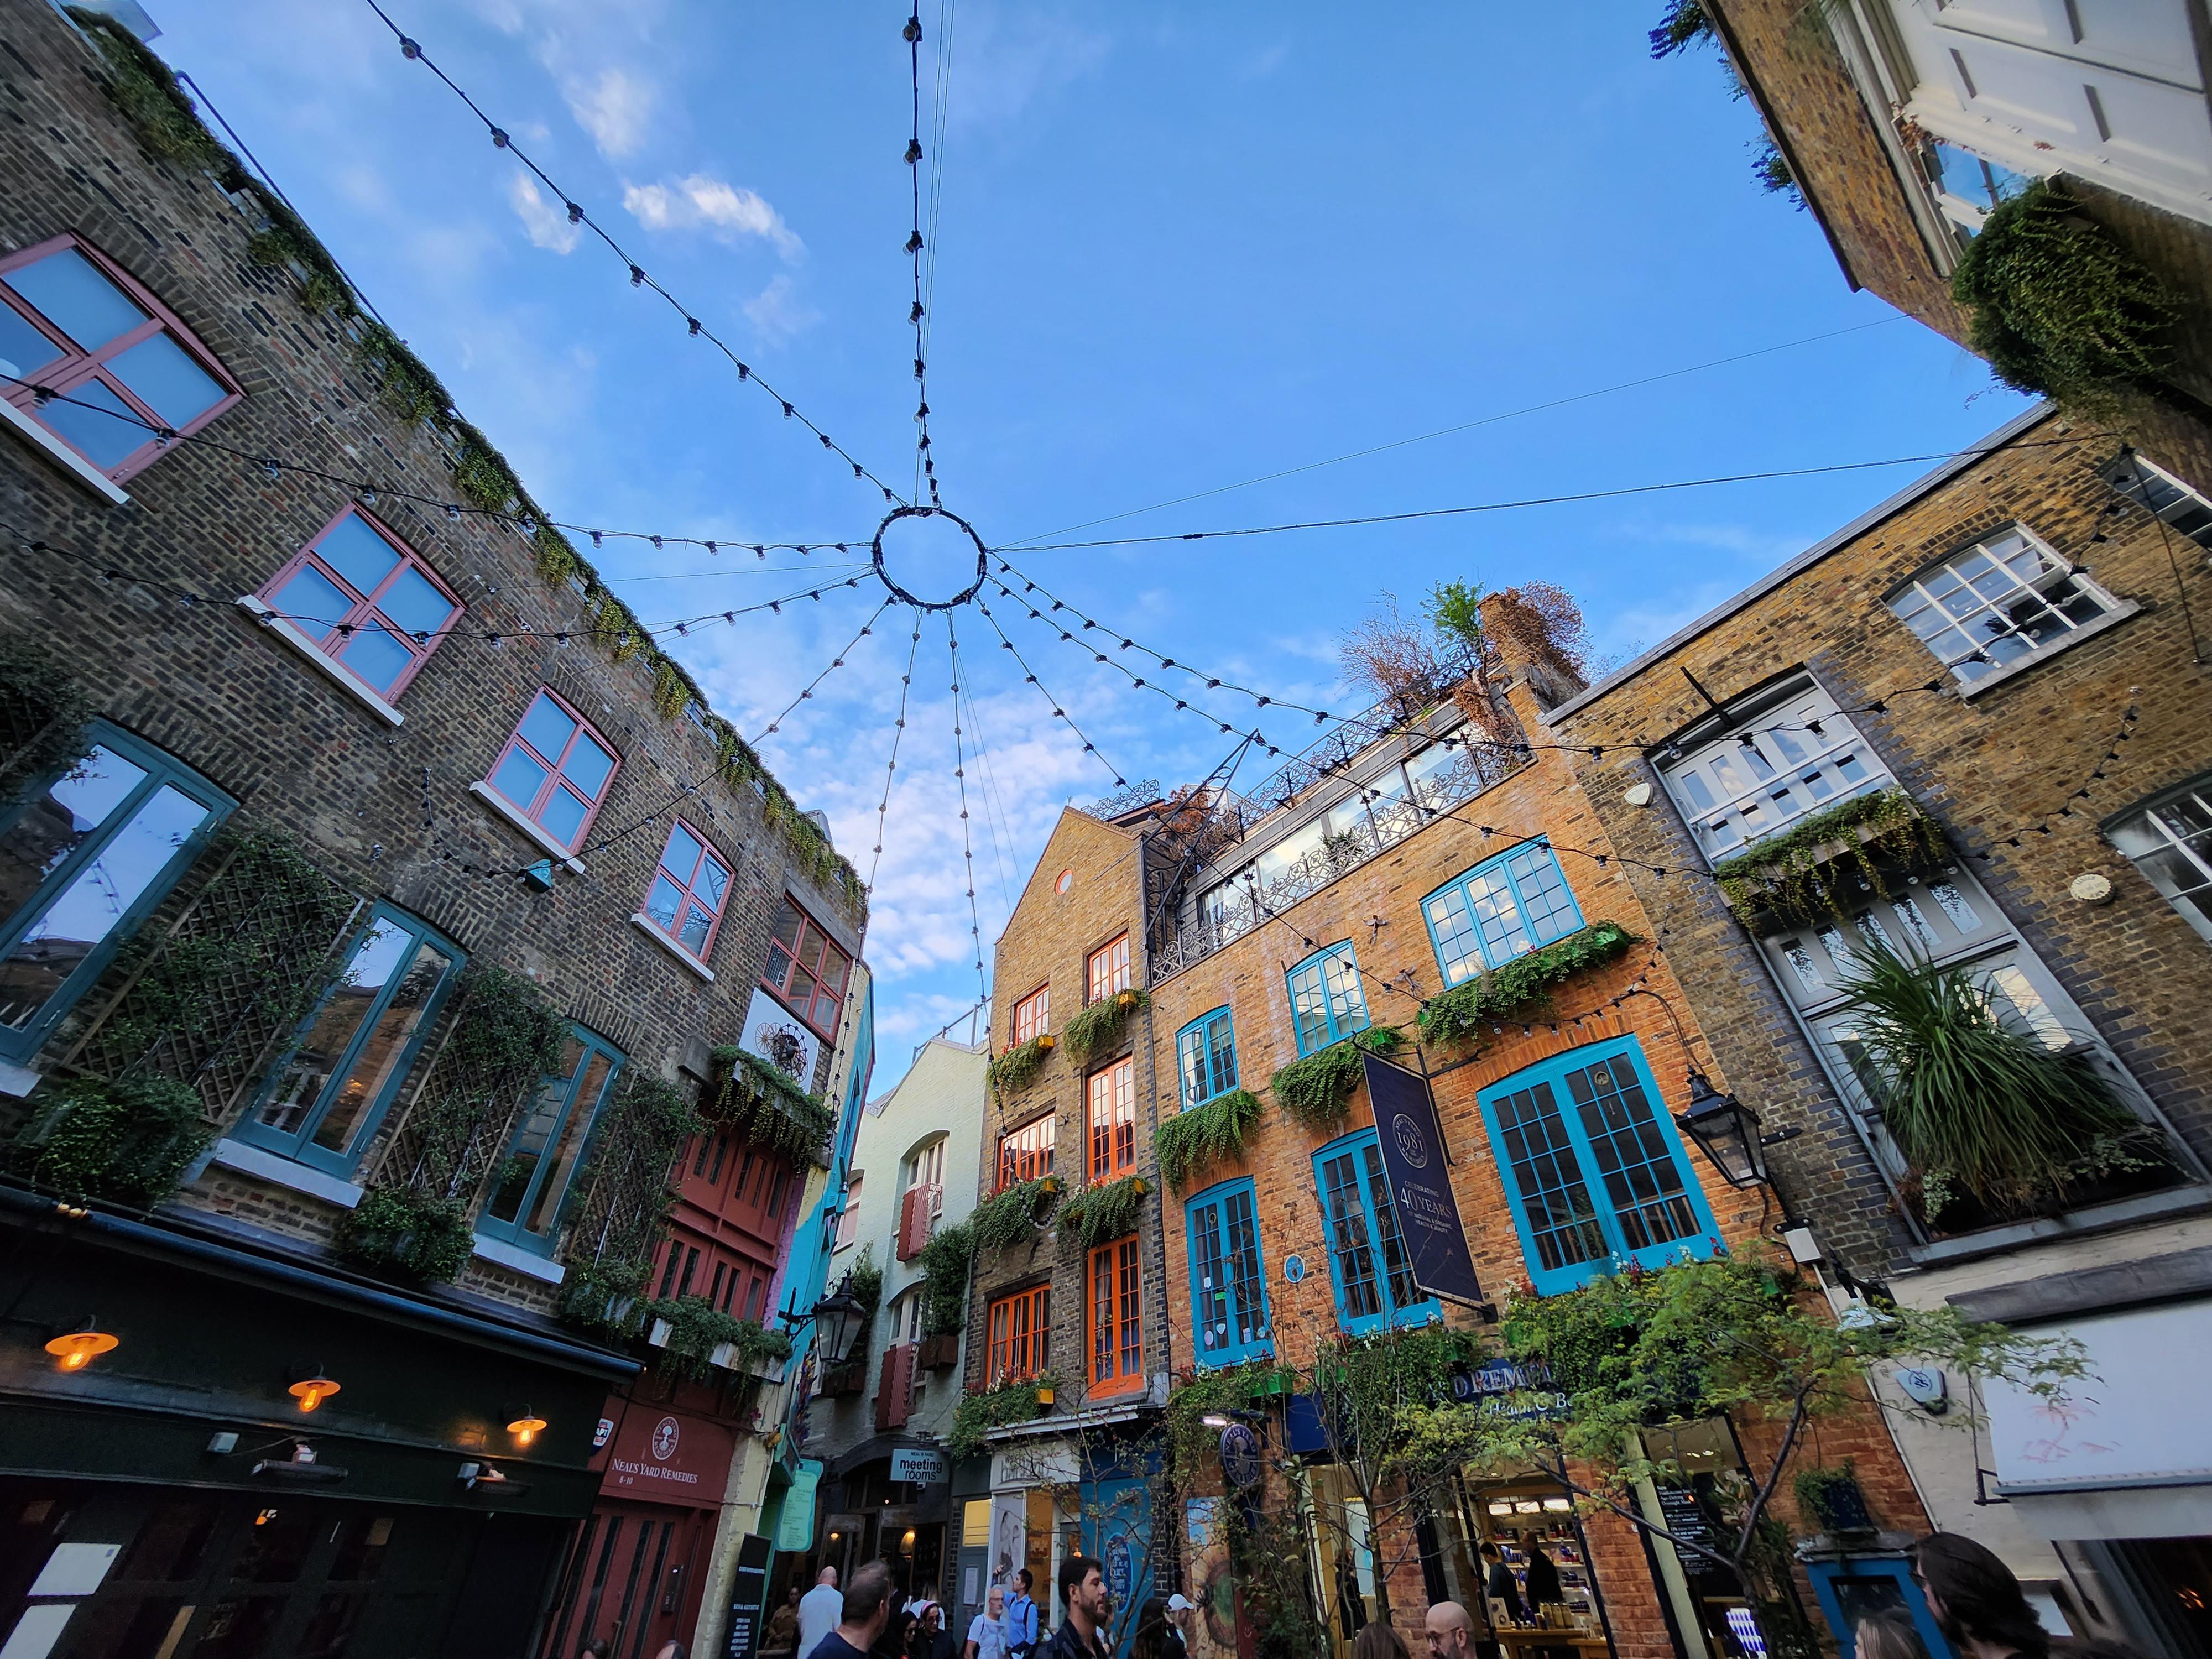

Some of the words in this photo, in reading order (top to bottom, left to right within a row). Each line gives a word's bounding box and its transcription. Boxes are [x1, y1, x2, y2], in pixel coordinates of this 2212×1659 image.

[1397, 1131, 1423, 1151] 1981
[1405, 1180, 1439, 1197] CELEBRATING
[1400, 1187, 1418, 1211] 40
[1417, 1196, 1452, 1218] YEARS
[639, 1463, 660, 1477] YARD
[660, 1467, 698, 1484] REMEDIES
[900, 1458, 943, 1474] meeting
[905, 1470, 936, 1481] rooms
